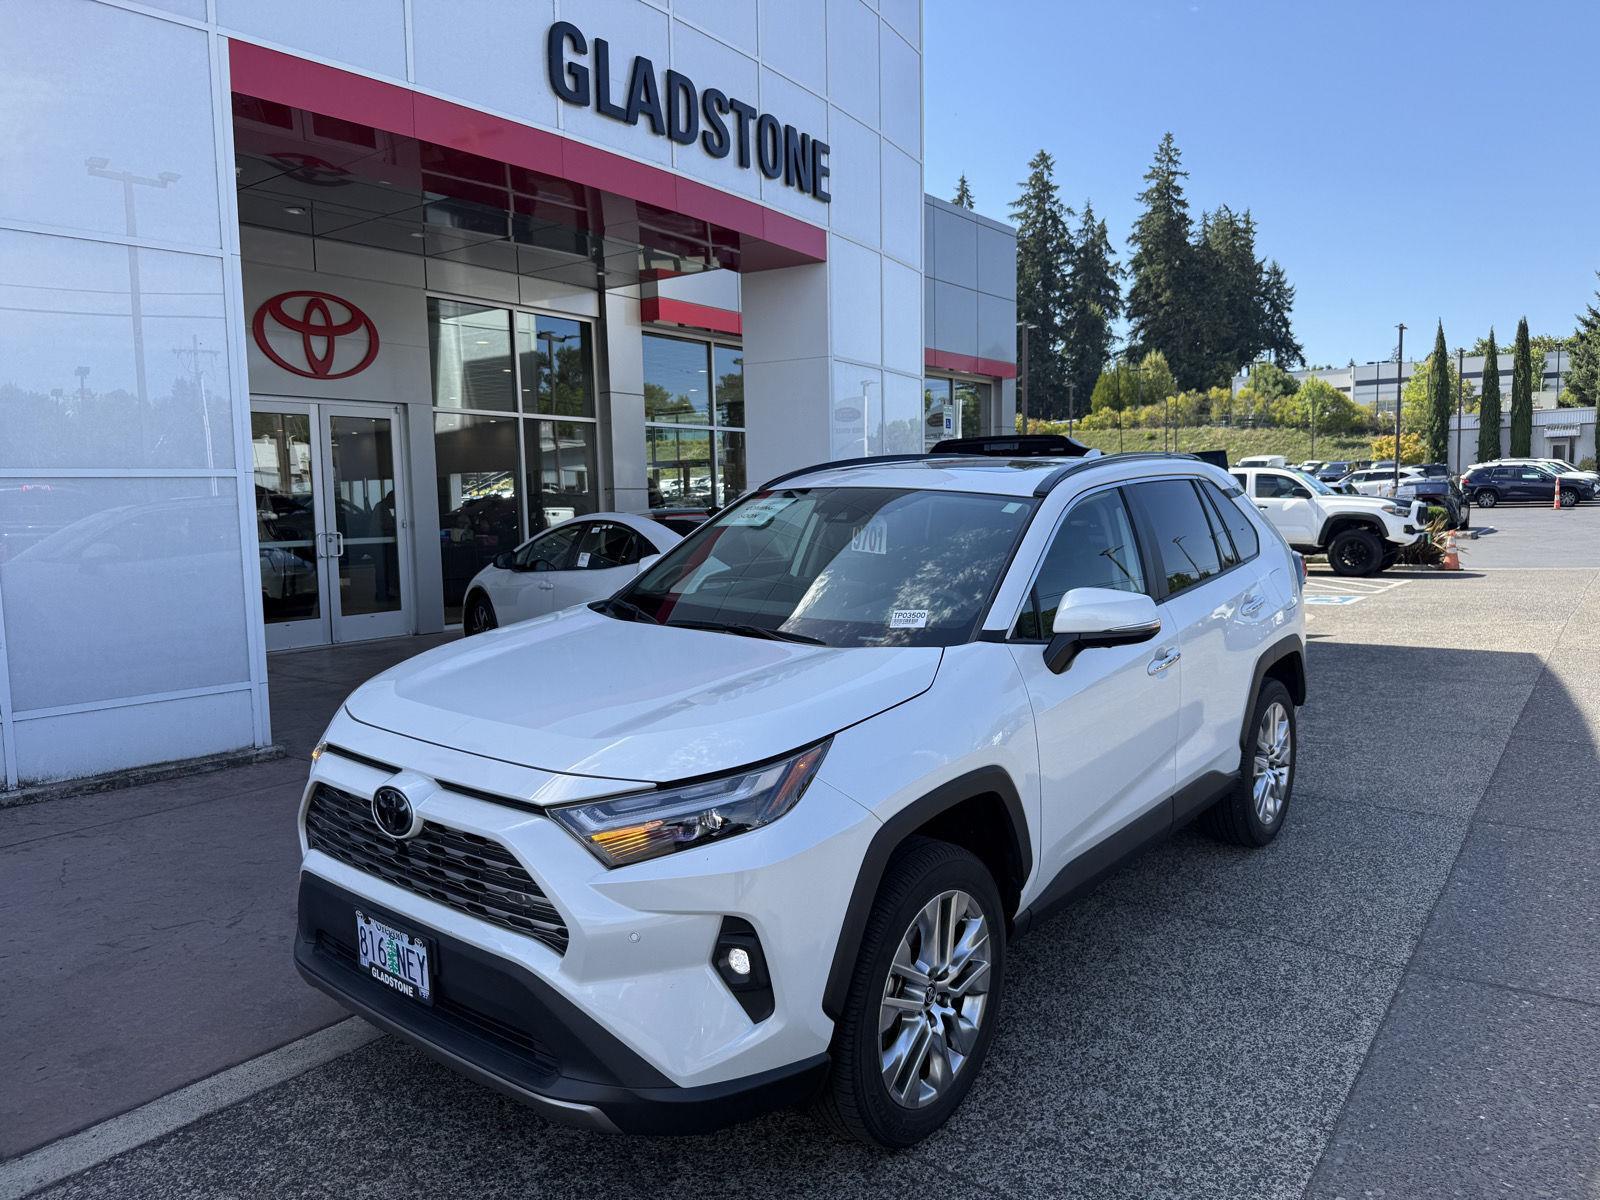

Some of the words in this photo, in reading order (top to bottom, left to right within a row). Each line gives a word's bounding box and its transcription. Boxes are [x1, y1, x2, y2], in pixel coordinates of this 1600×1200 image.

[548, 21, 831, 202] GLADSTONE
[360, 926, 387, 967] 816
[396, 943, 426, 987] NEY
[371, 966, 413, 997] GLADSTONE
